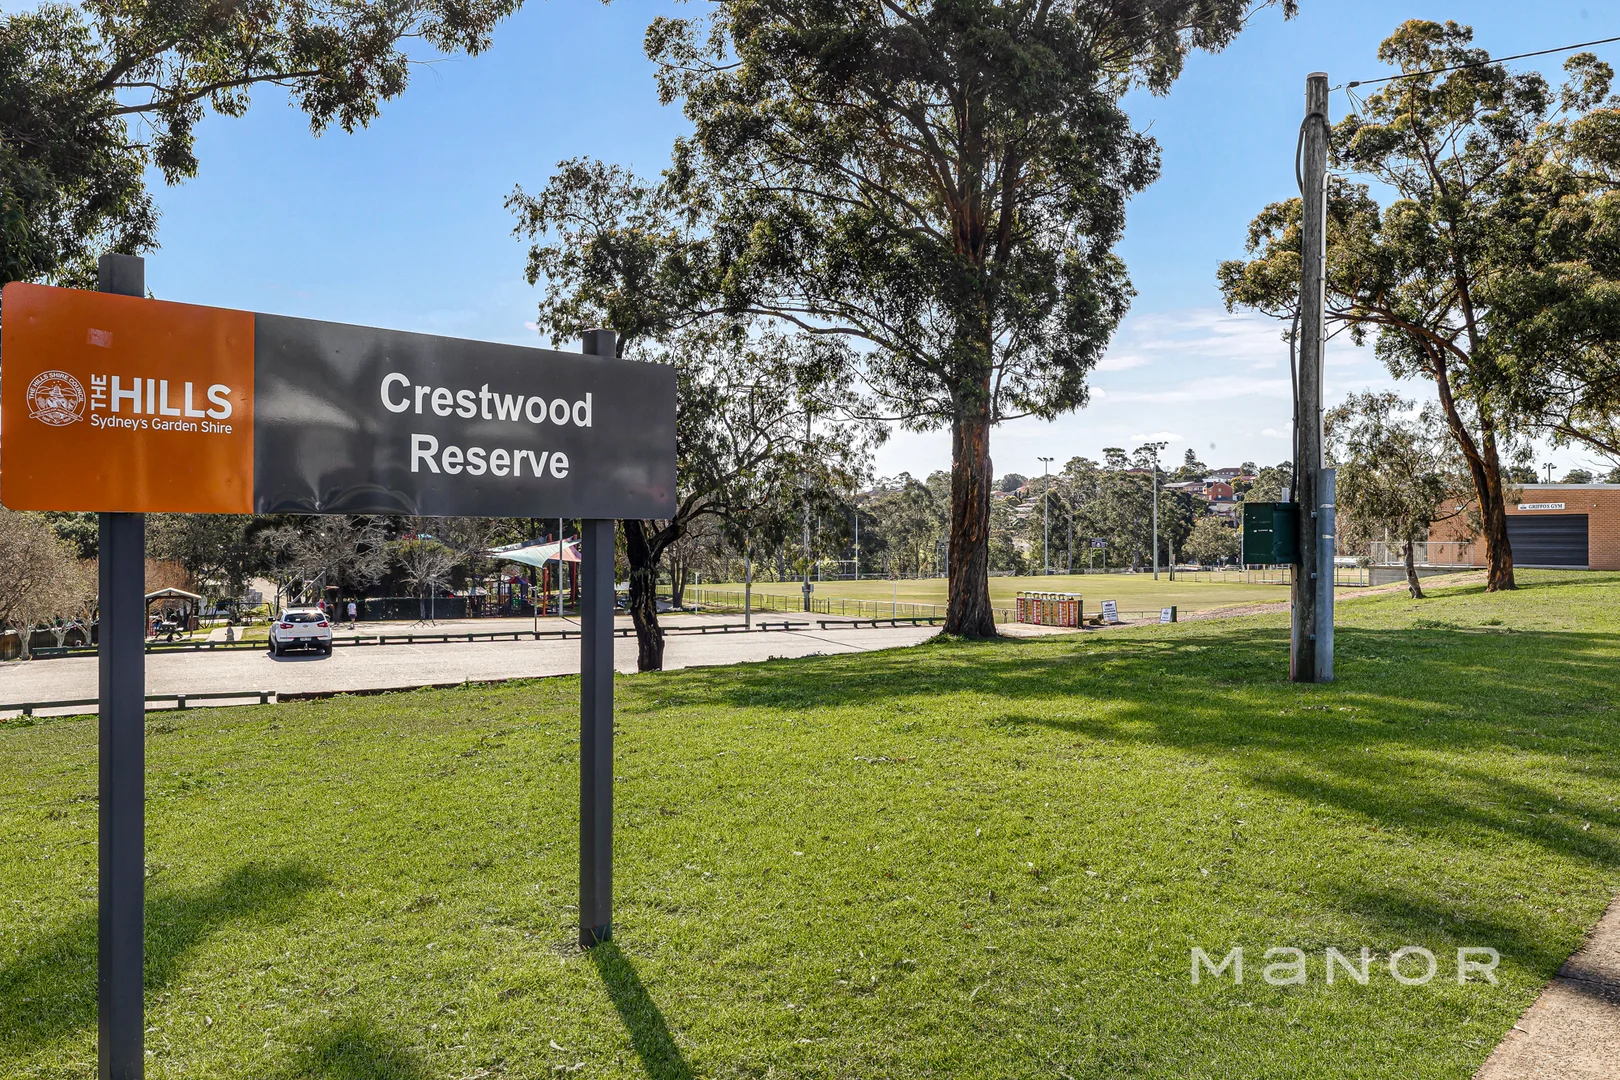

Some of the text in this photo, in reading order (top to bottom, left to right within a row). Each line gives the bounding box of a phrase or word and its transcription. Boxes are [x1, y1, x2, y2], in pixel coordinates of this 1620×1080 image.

[32, 374, 49, 388] HILLS
[49, 373, 70, 381] SHIRE
[69, 378, 84, 403] COUNCIL
[91, 373, 107, 411] THE
[111, 375, 233, 420] HILLS
[380, 372, 593, 428] Crestwood
[90, 413, 149, 431] Sydney's
[151, 417, 198, 432] Garden
[200, 420, 233, 434] Shire
[410, 433, 570, 479] Reserve
